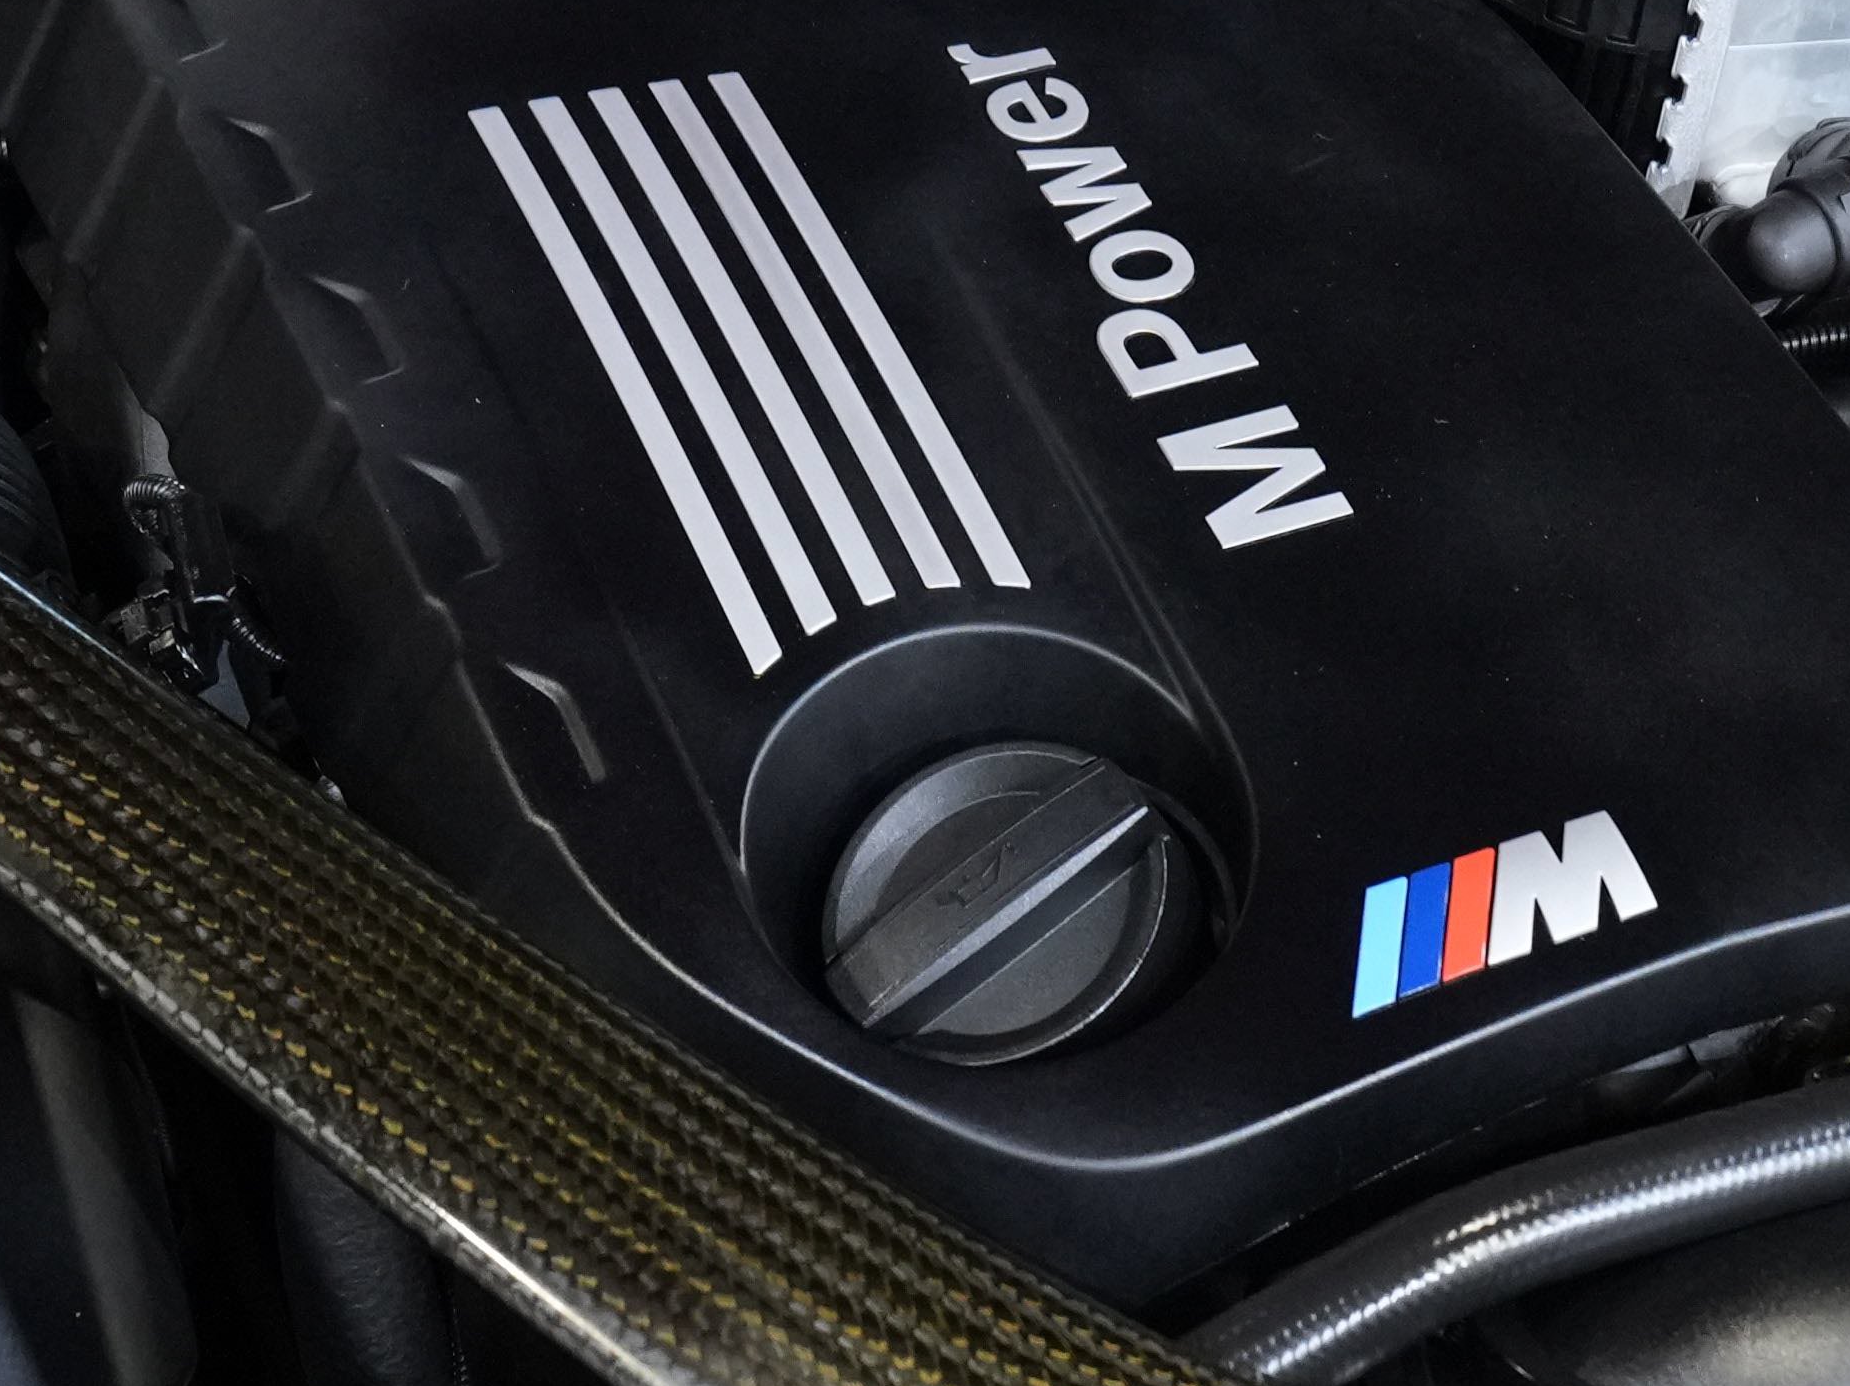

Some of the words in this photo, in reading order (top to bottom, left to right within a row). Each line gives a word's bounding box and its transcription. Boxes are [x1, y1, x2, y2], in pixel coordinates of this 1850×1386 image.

[947, 44, 1259, 399] Power
[1156, 404, 1354, 549] M
[1487, 810, 1658, 968] M
